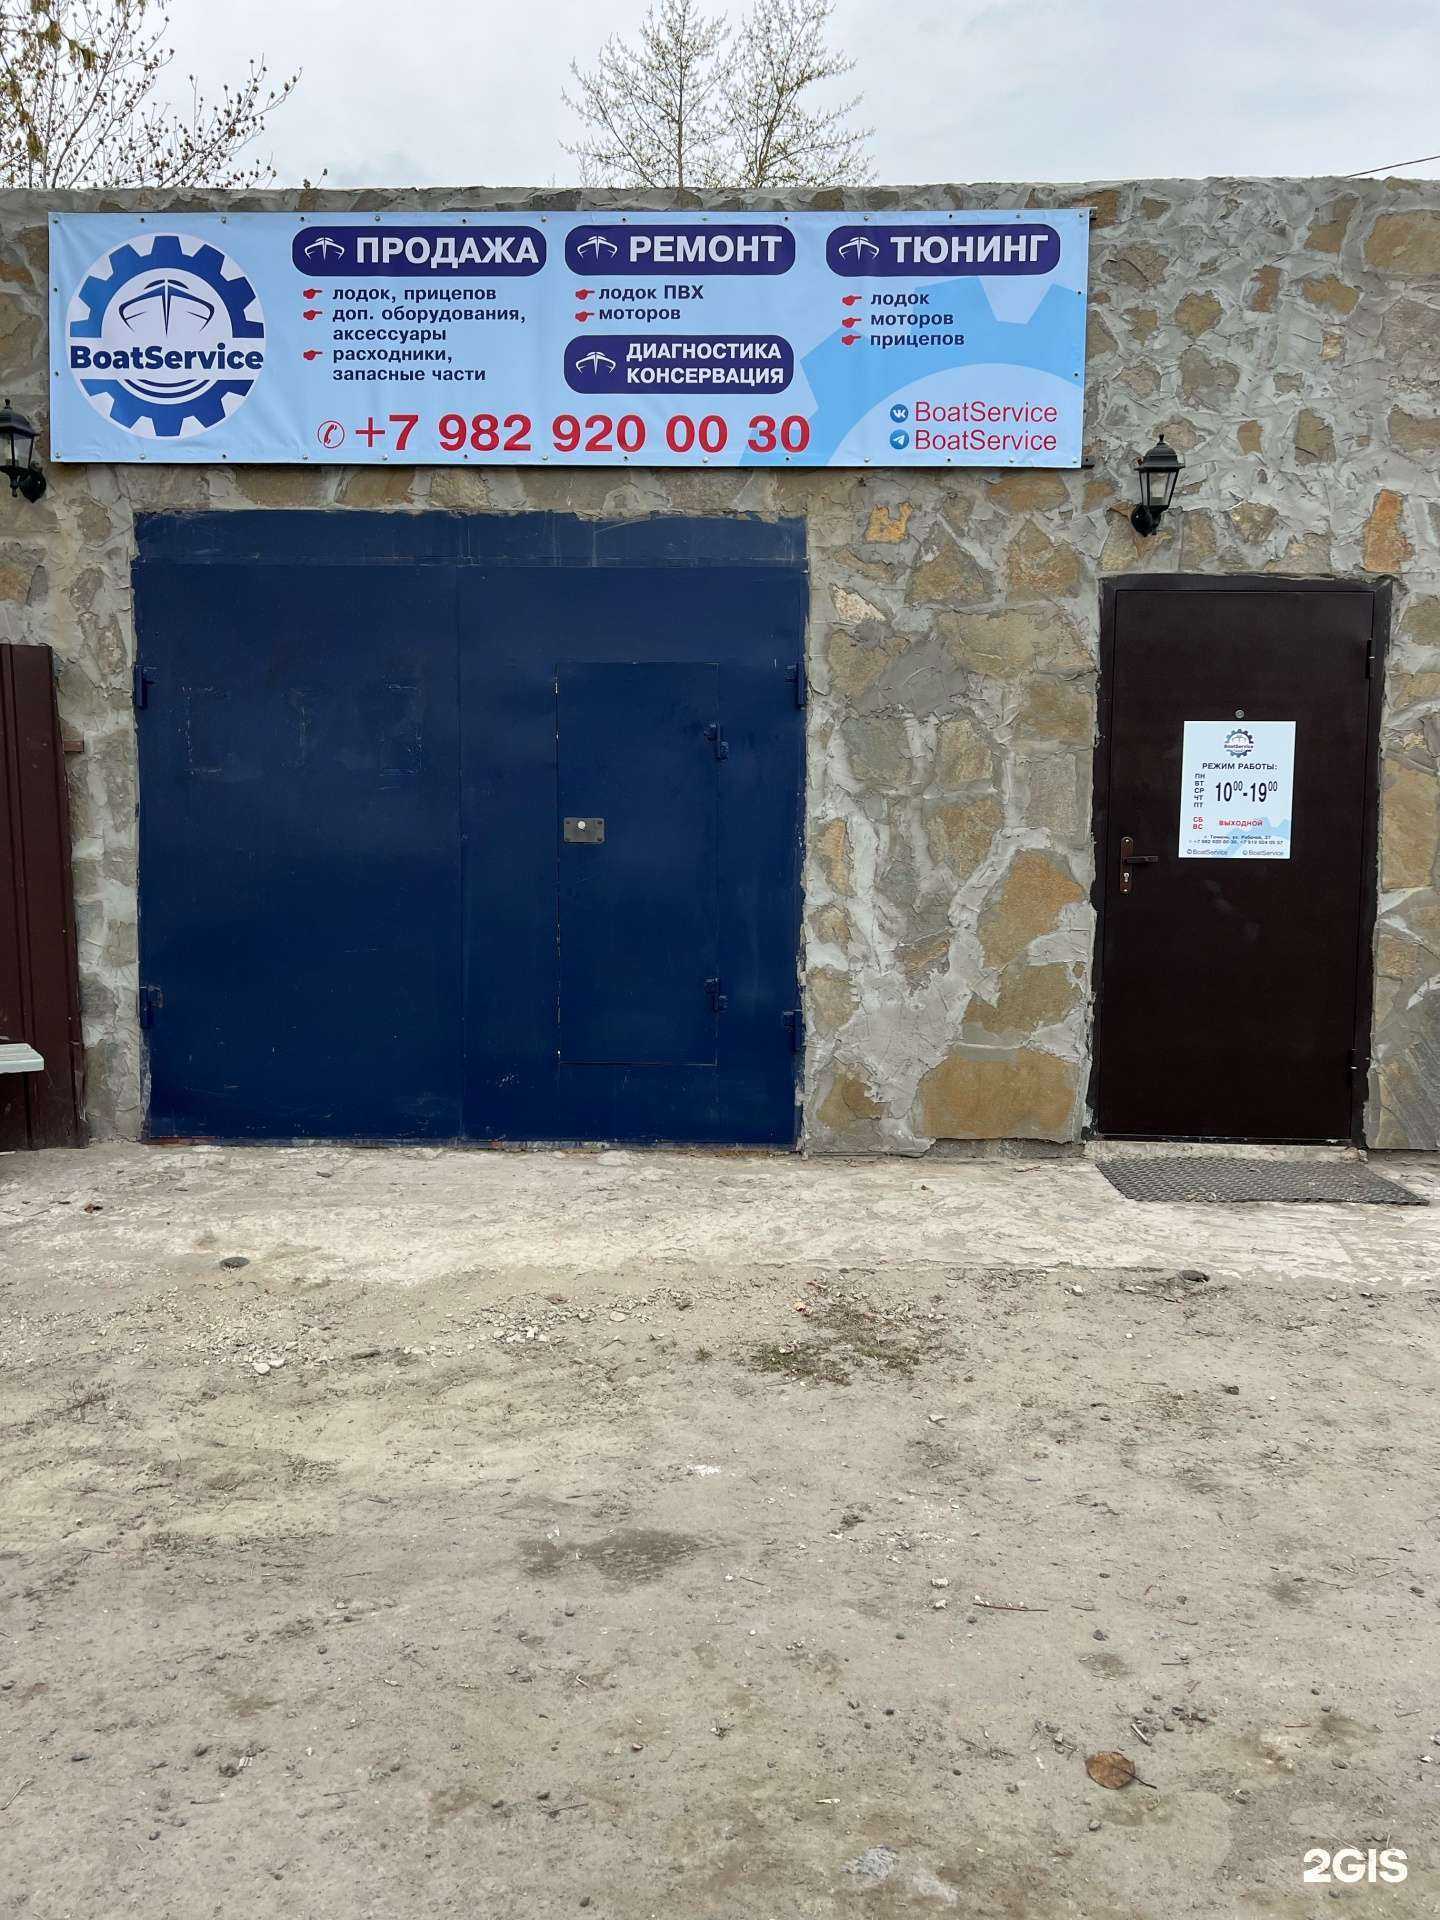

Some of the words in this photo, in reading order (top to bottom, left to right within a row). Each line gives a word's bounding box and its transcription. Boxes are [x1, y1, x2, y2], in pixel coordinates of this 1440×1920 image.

[356, 236, 539, 269] ПРОДАЖА
[629, 235, 783, 263] РЕМОНТ
[890, 234, 1049, 264] ТЮНИНГ
[332, 288, 397, 303] лодок,
[404, 288, 497, 303] прицепов
[598, 288, 657, 303] лодок
[664, 284, 704, 300] ПВХ
[870, 292, 930, 307] лодок
[332, 309, 375, 323] доп.
[381, 306, 526, 324] оборудования,
[599, 308, 681, 323] моторов
[870, 313, 954, 329] моторов
[333, 328, 447, 344] аксессуары
[870, 333, 965, 349] прицепов
[69, 342, 264, 370] BoatService
[333, 349, 453, 364] расходники,
[626, 342, 782, 363] ДИАГНОСТИКА
[333, 369, 426, 382] запасные
[432, 368, 487, 382] части
[627, 367, 784, 387] КОНСЕРВАЦИЯ
[915, 401, 1057, 423] BoatService
[355, 414, 419, 451] +7
[438, 414, 532, 452] 982
[552, 414, 647, 452] 920
[665, 414, 729, 452] 00
[747, 414, 811, 453] 30
[915, 429, 1057, 451] BoatService
[1202, 762, 1235, 770] РЕЖИМ
[1218, 819, 1264, 827] ВЫХОДНОЙ
